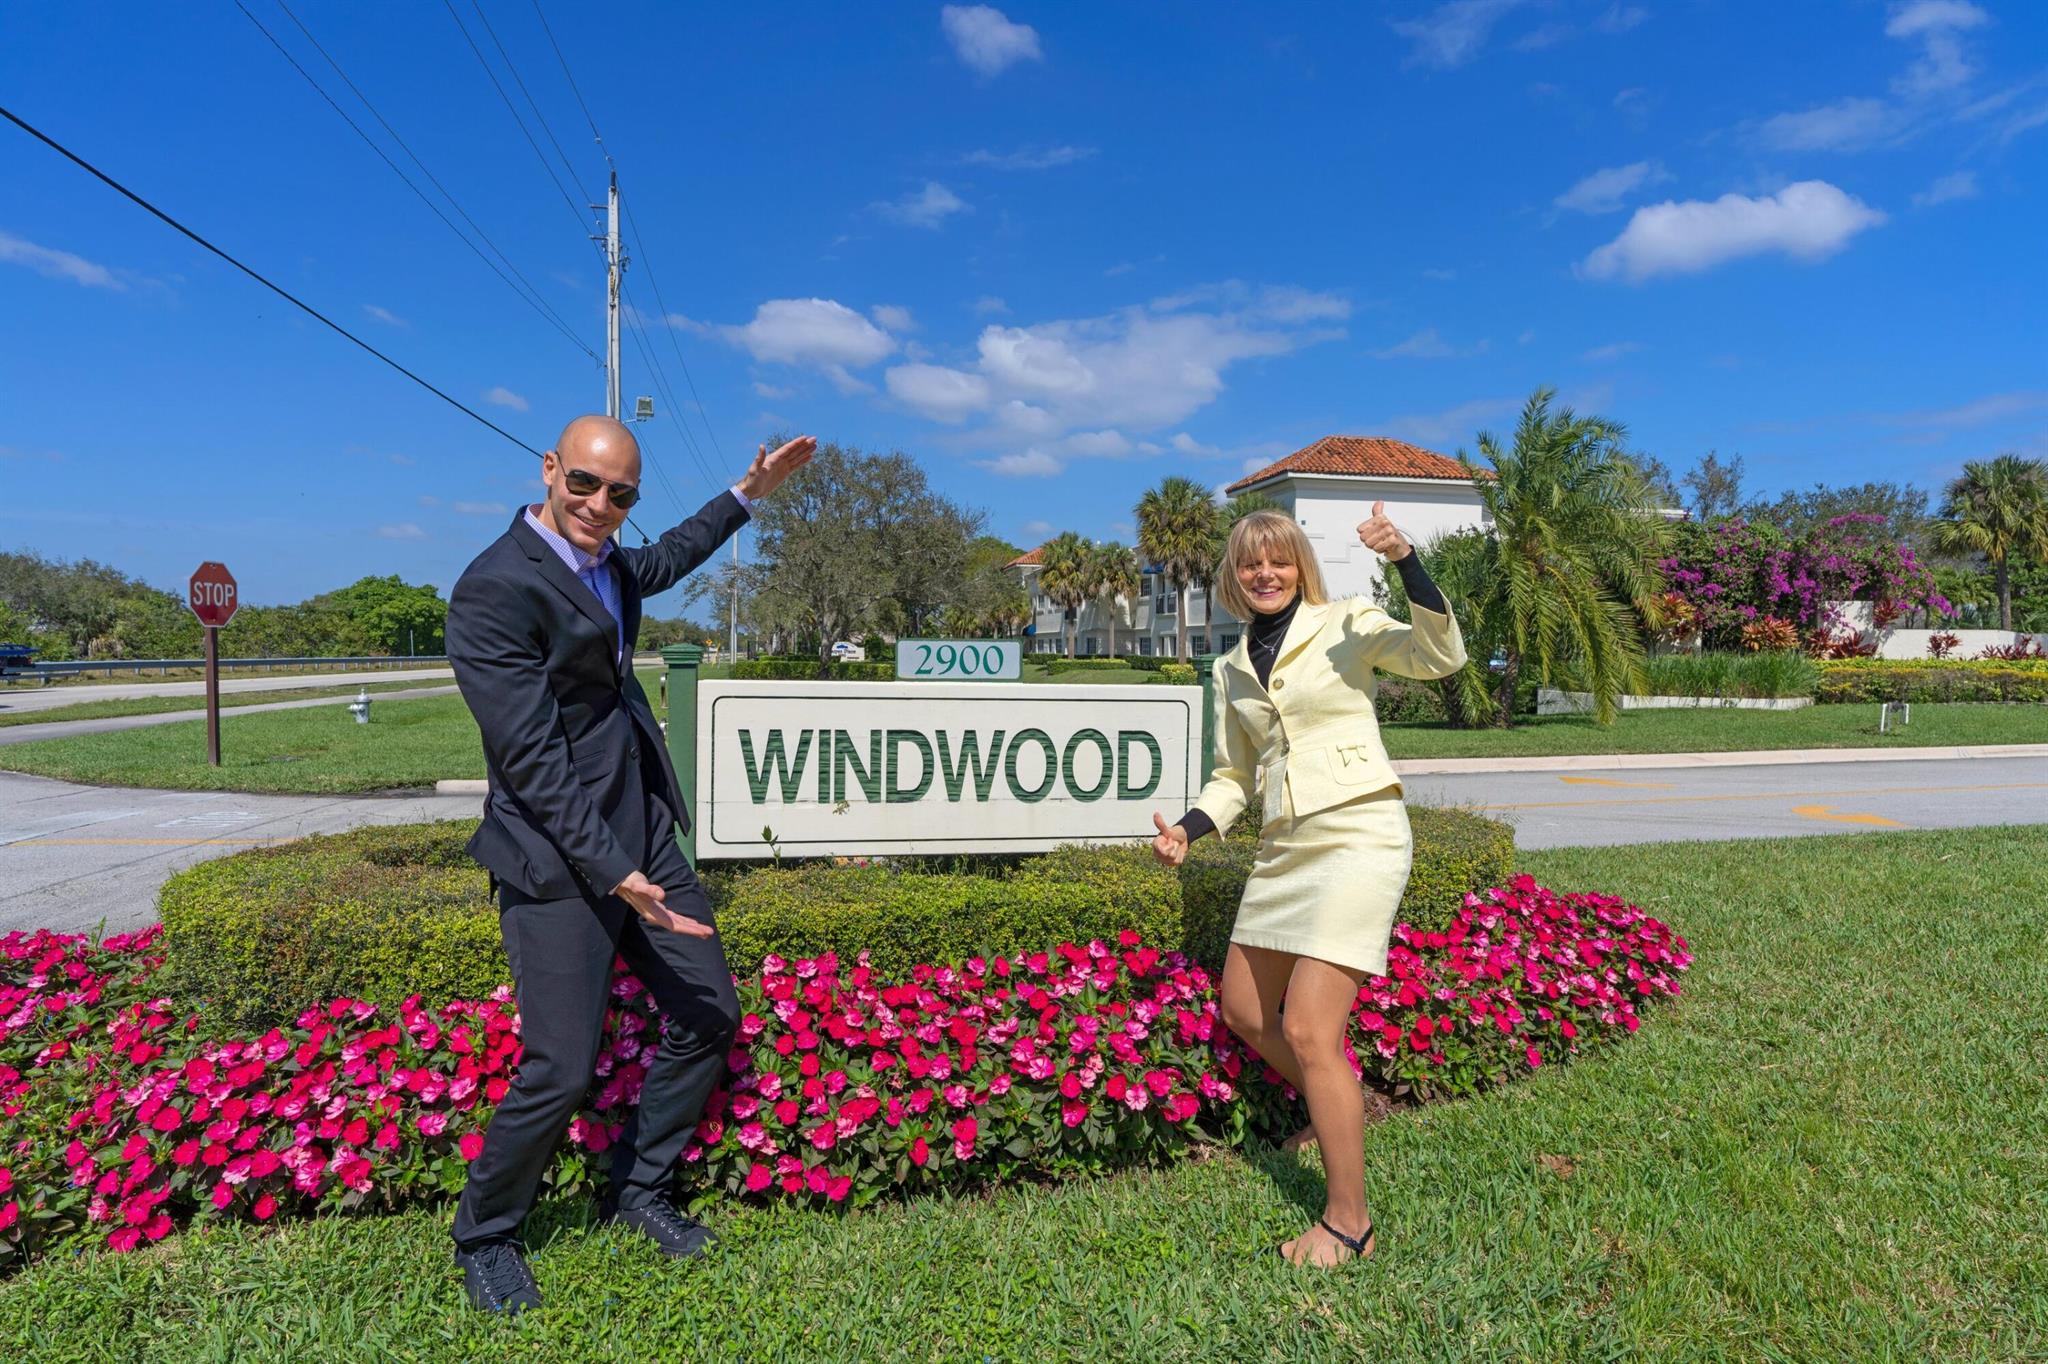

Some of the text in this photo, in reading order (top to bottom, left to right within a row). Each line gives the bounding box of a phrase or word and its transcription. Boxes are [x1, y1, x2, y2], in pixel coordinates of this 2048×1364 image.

[193, 582, 234, 606] STOP
[915, 645, 1003, 675] 2900
[738, 728, 1162, 804] WINDWOOD
